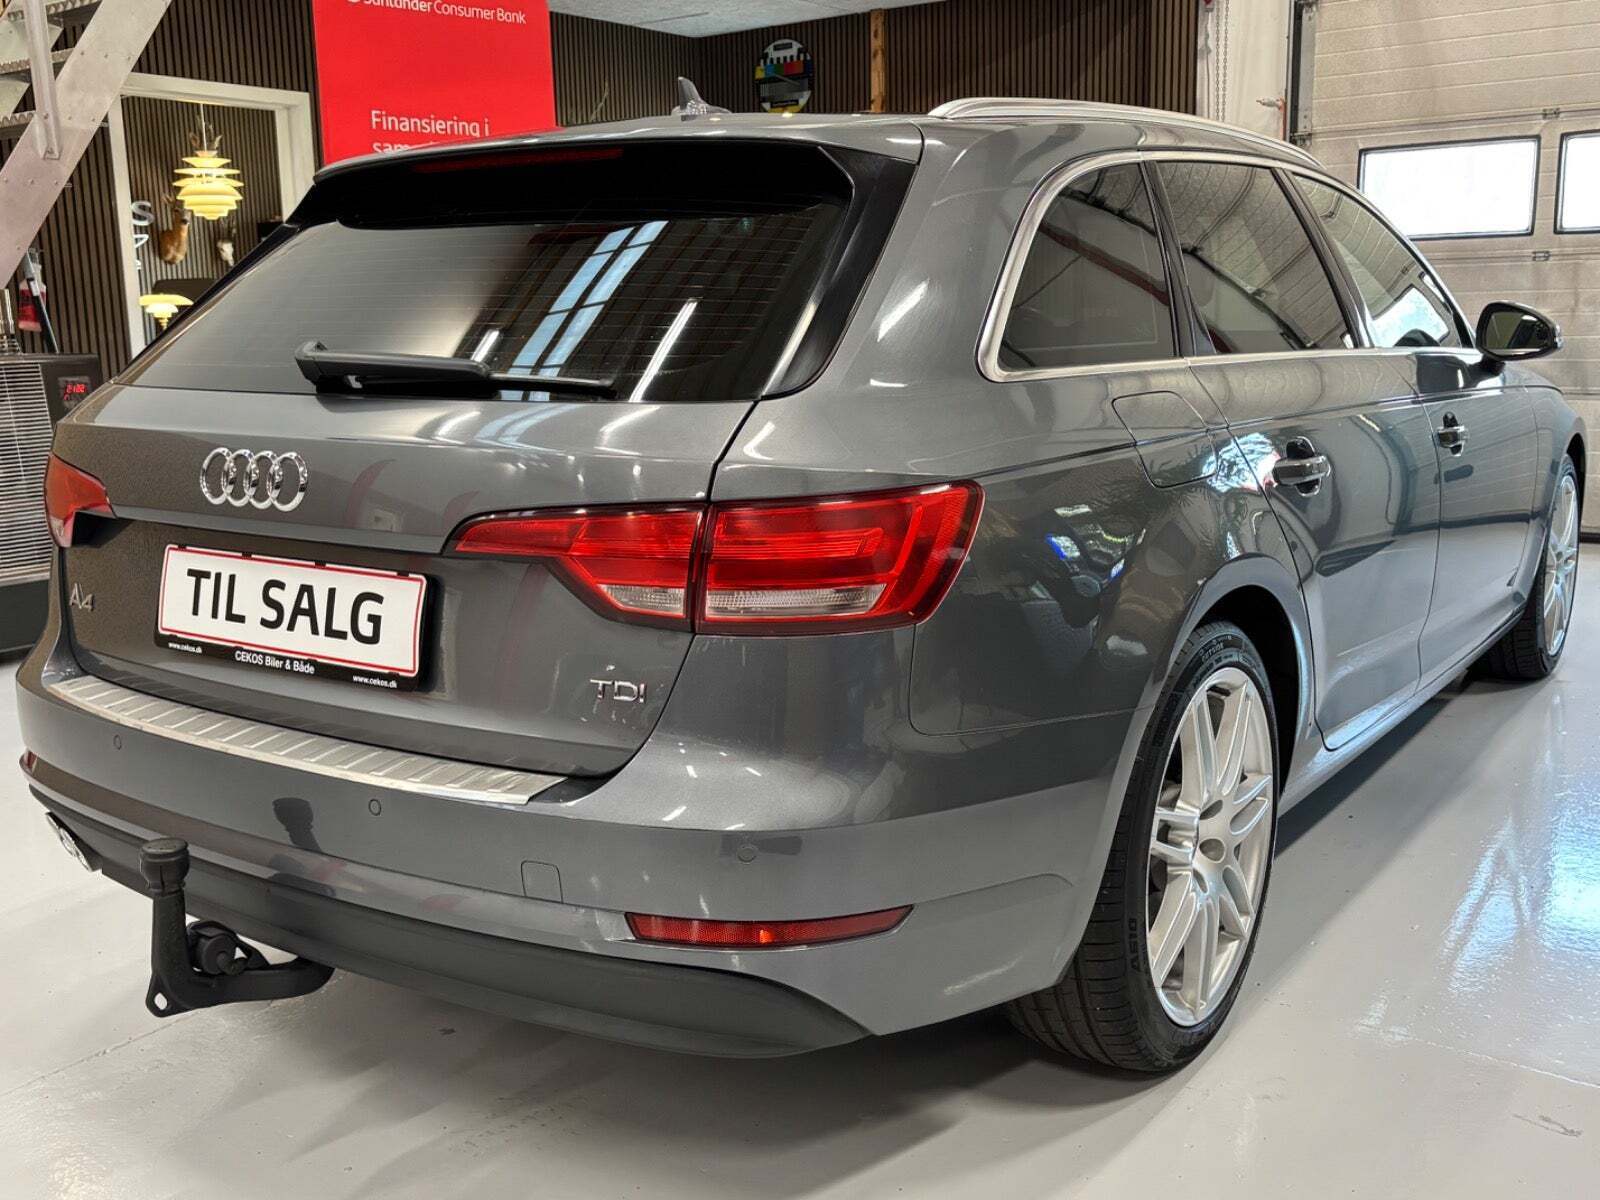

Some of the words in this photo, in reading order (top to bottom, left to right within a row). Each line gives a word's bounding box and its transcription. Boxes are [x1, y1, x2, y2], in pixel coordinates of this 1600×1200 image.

[433, 0, 495, 20] Consumer
[496, 8, 526, 24] Bank
[371, 110, 480, 138] Finansiering
[484, 118, 490, 137] i
[69, 583, 94, 612] A4
[187, 568, 246, 624] TIL
[260, 579, 385, 645] SALG
[168, 642, 202, 654] www.cekos.dk
[234, 650, 263, 666] CEKOS
[265, 655, 284, 669] Biler
[285, 659, 292, 670] &
[293, 660, 315, 675] Både
[352, 674, 398, 688] www.cekos.dk
[589, 678, 645, 703] TDI
